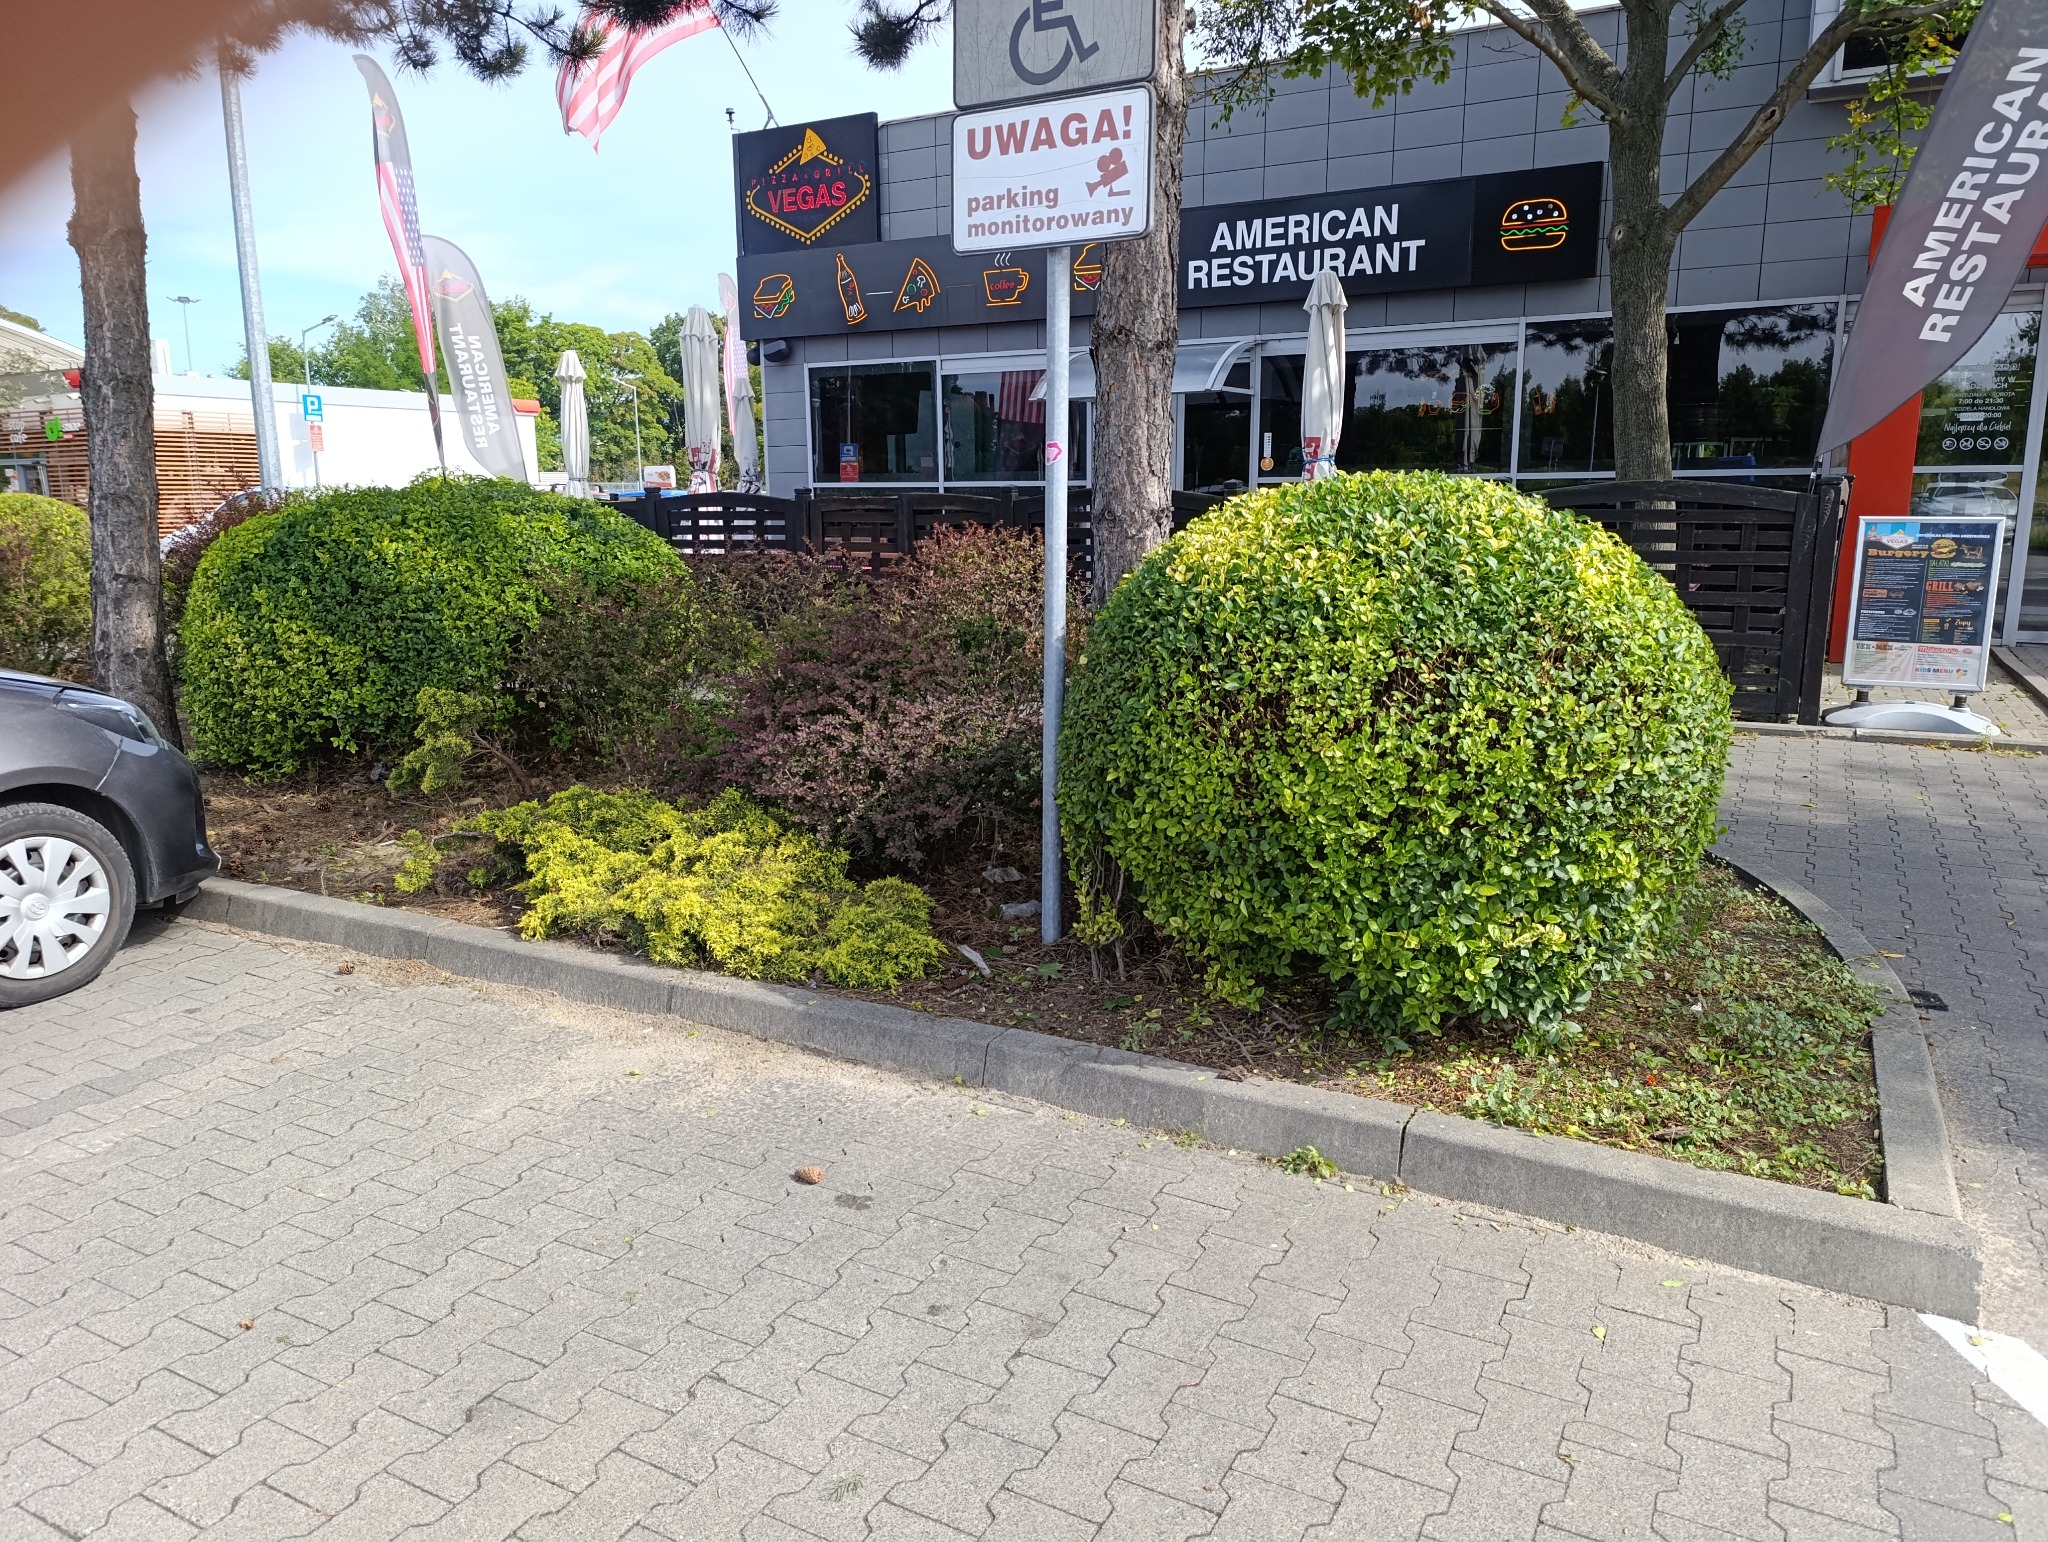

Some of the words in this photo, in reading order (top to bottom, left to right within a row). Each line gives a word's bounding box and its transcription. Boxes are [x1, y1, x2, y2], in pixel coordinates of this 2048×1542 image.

[967, 105, 1132, 160] UWAGA!
[751, 174, 798, 186] PIZZA
[814, 164, 864, 179] GRILL
[1902, 47, 2048, 307] AMERICAN
[767, 181, 847, 214] VEGAS
[967, 185, 1059, 217] parking
[967, 206, 1134, 238] monitorowany
[1210, 203, 1399, 252] AMERICAN
[1187, 239, 1426, 290] RESTAURANT
[990, 279, 1015, 290] coffee
[307, 396, 319, 414] P
[1943, 422, 1975, 434] Najlepszy
[1977, 422, 1987, 432] dla
[1868, 548, 1929, 558] Burgery
[1926, 581, 1953, 591] GRILL
[1954, 619, 1971, 627] Zupy
